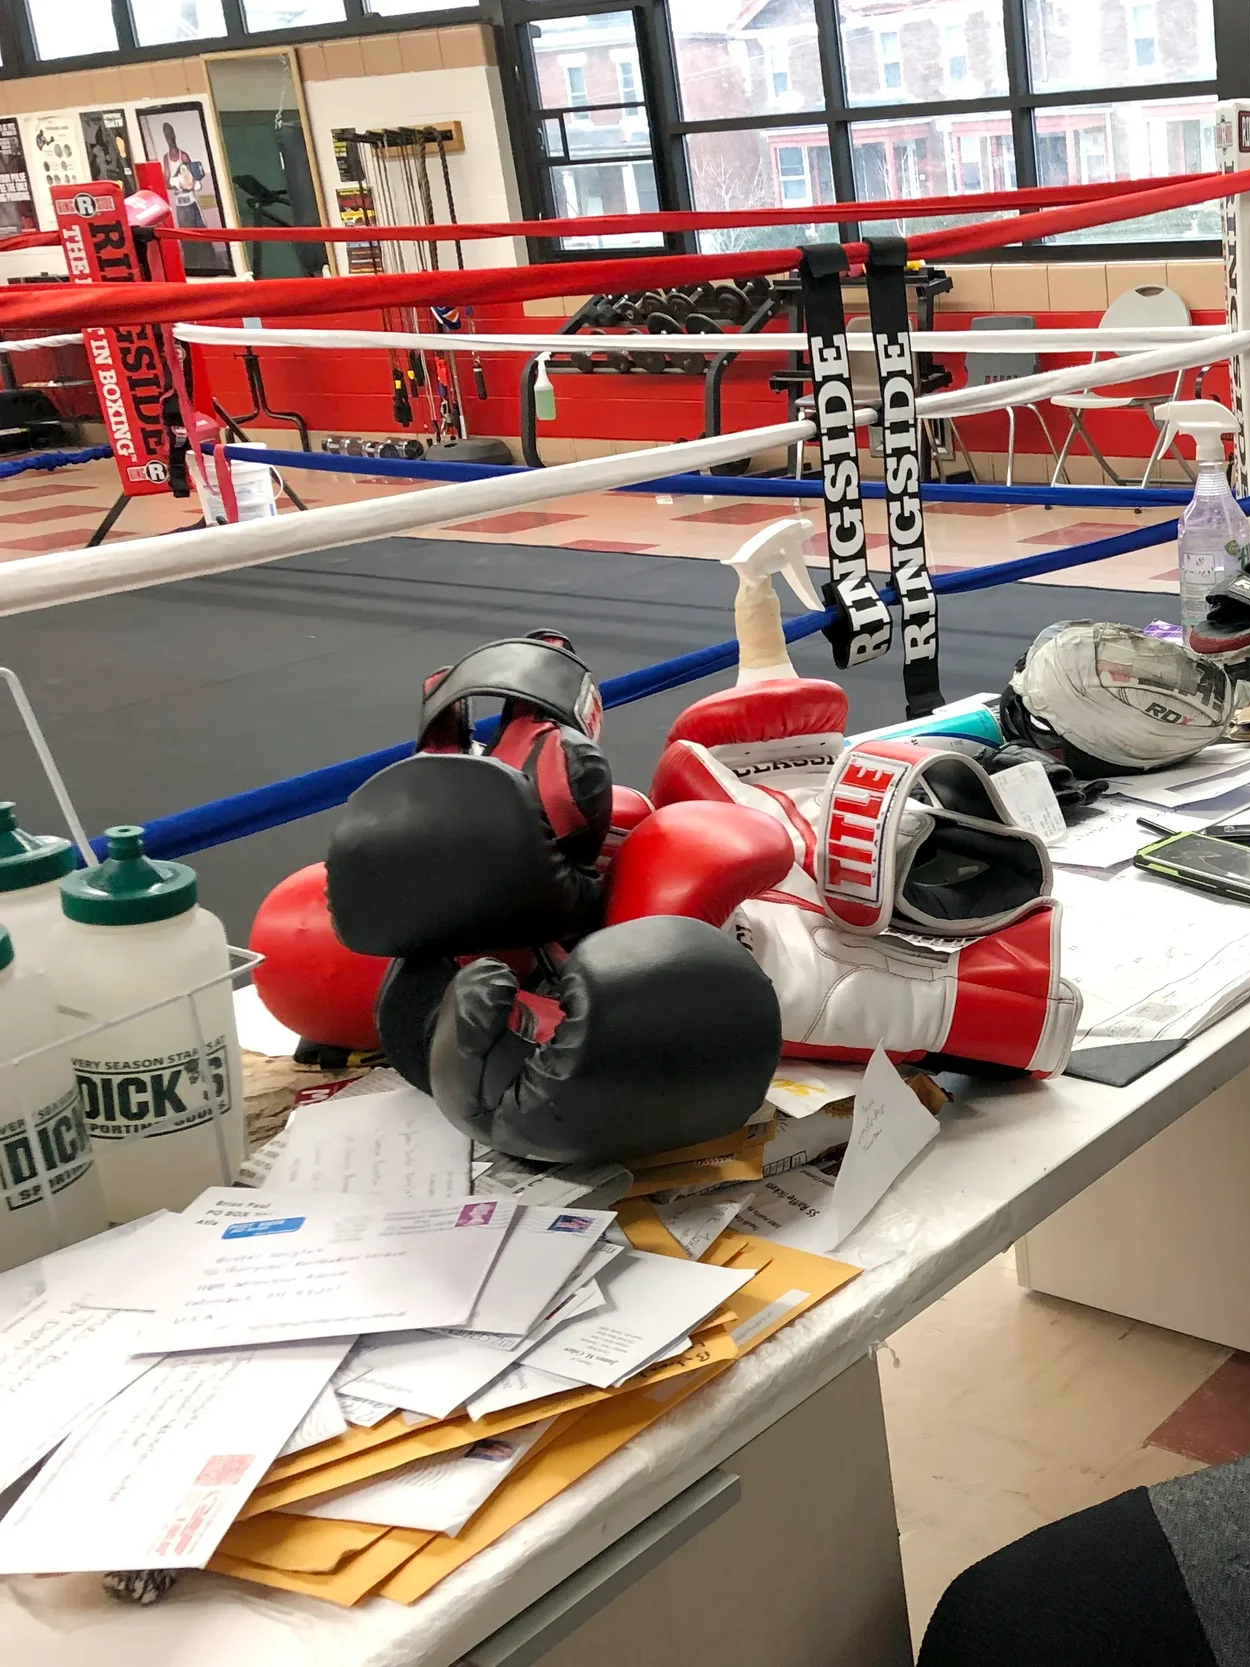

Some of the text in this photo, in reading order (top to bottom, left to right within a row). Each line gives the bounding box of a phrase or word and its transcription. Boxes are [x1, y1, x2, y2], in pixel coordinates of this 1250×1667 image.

[62, 225, 90, 275] THE
[90, 338, 113, 366] IN
[97, 369, 136, 457] BOXING
[810, 334, 892, 668] RINGSIDE
[876, 332, 937, 665] RINGSIDE
[1144, 701, 1193, 726] RDX
[828, 763, 895, 888] TITLE
[104, 1056, 164, 1071] SEASON
